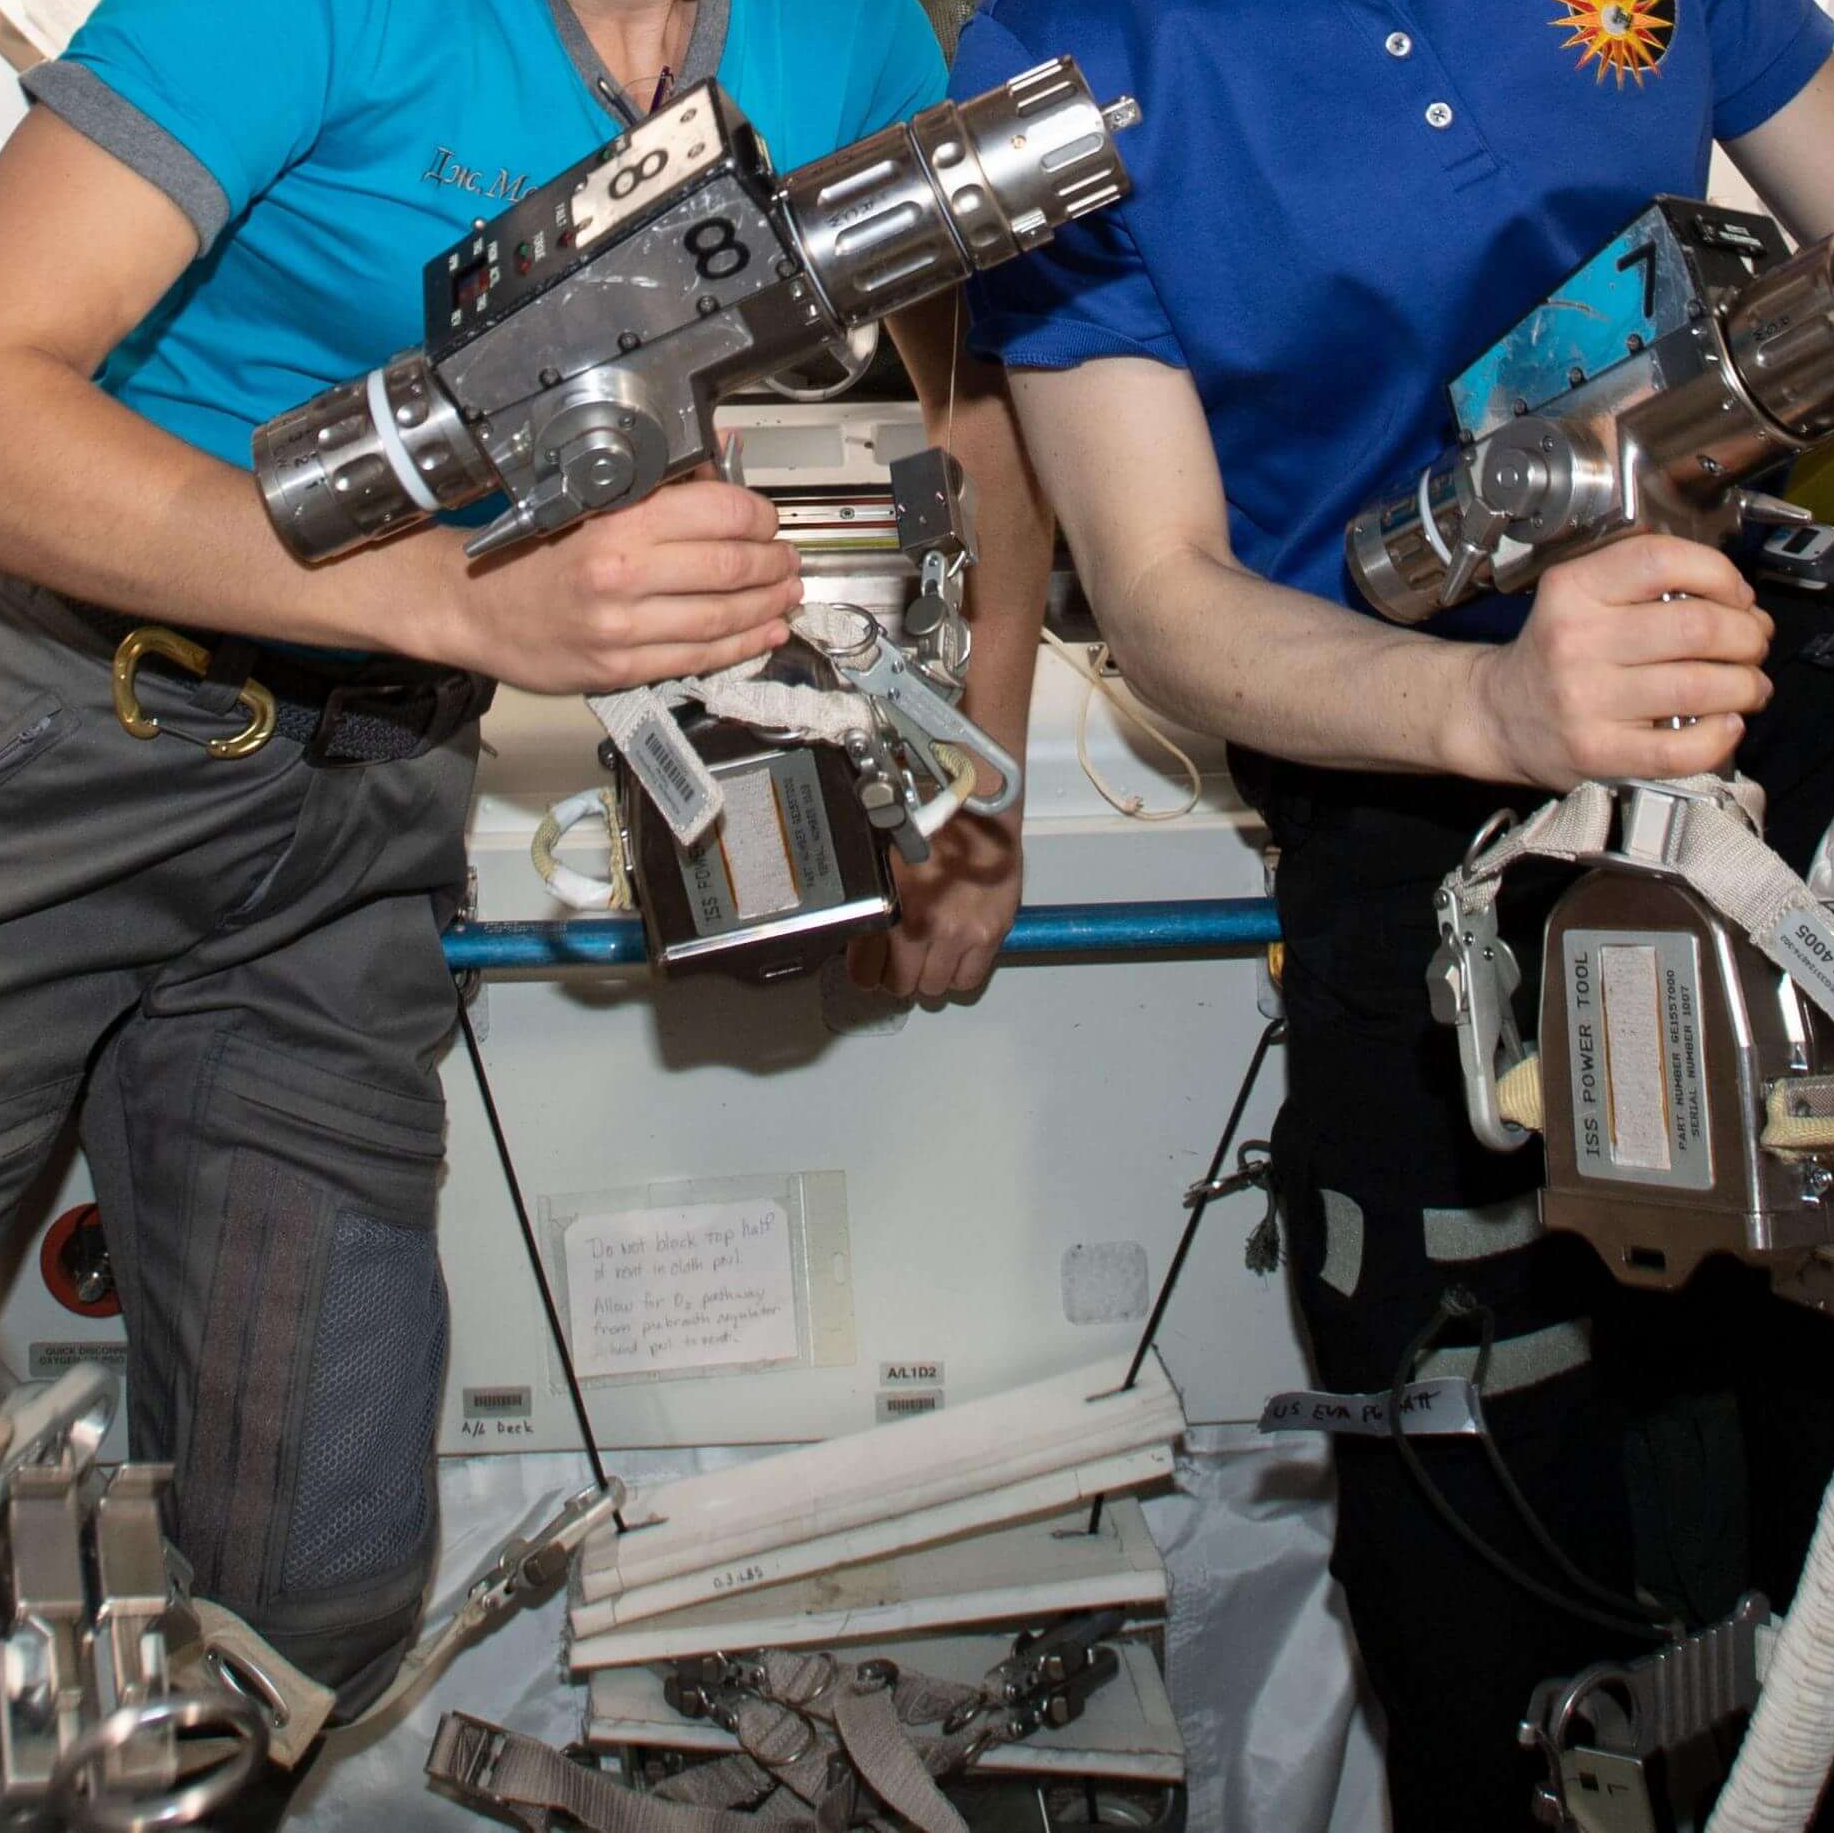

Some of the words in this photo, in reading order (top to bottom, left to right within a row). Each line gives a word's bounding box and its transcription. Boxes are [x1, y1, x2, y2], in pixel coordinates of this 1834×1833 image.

[608, 149, 668, 200] 8
[683, 217, 752, 283] 8
[1616, 243, 1657, 319] 7
[703, 895, 720, 923] ISS
[1795, 924, 1834, 963] 4005
[1575, 952, 1592, 1010] TOOL
[1680, 985, 1692, 1017] 1007
[1578, 1024, 1596, 1104] POWER
[1682, 1024, 1696, 1079] NUMBER
[1672, 1052, 1683, 1106] NUMBER
[1687, 1087, 1701, 1138] SERIAL
[1585, 1118, 1601, 1157] ISS
[1673, 1116, 1688, 1151] PART
[655, 1230, 698, 1254] block
[593, 1295, 634, 1316] Allow
[887, 1366, 936, 1379] A/L1D2
[1313, 1404, 1351, 1421] EVA
